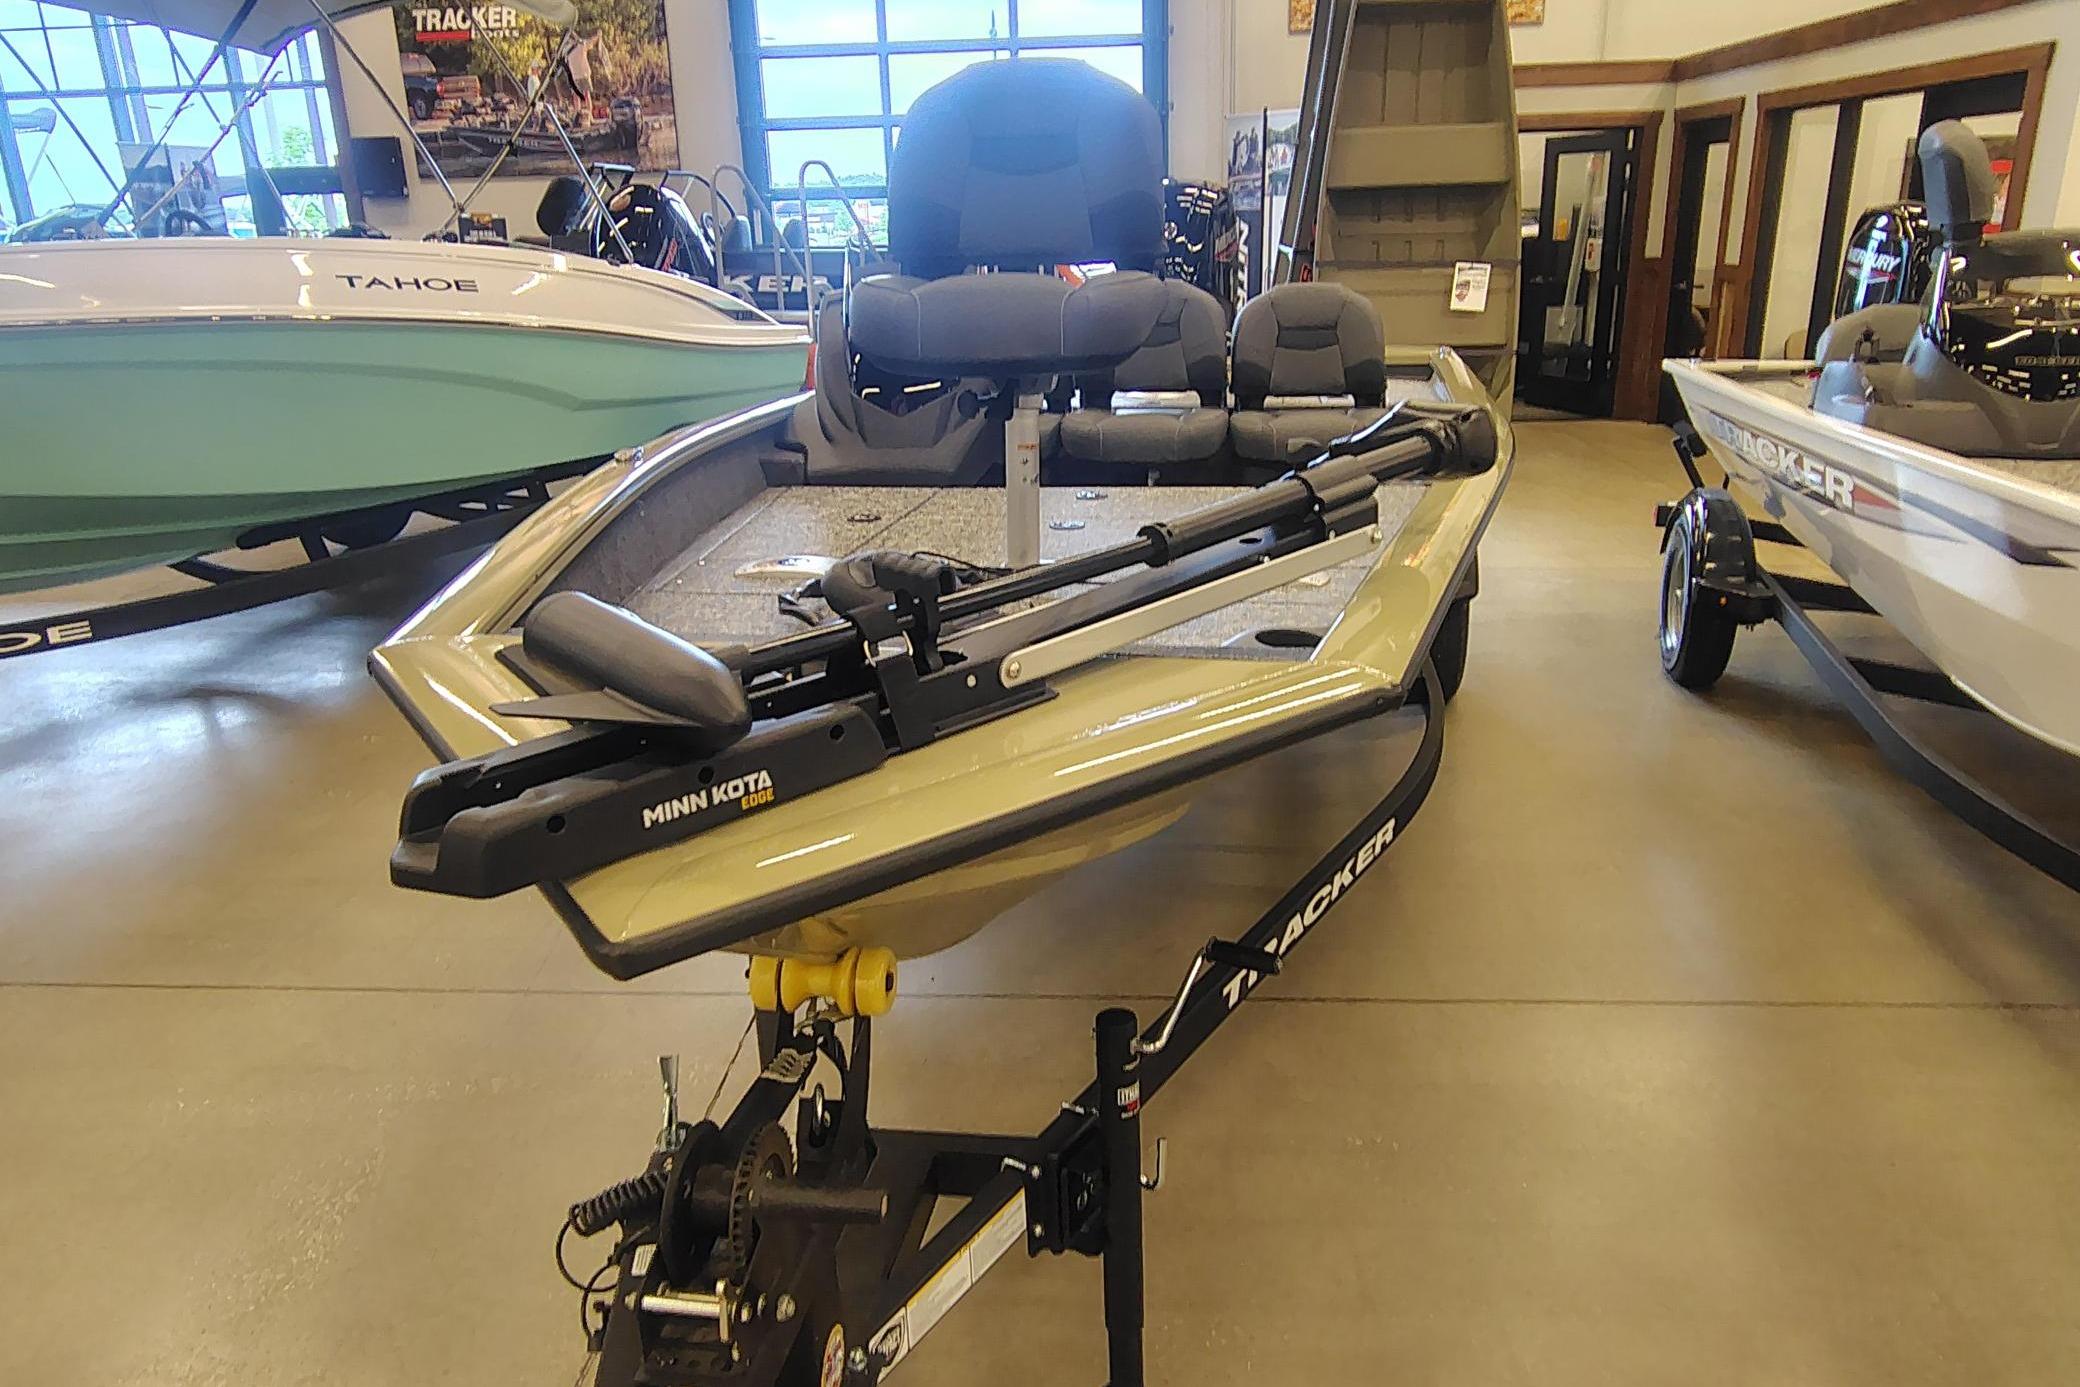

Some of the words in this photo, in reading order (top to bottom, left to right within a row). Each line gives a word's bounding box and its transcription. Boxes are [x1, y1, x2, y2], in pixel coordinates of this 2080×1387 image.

[412, 5, 517, 31] TRACKER
[335, 274, 479, 293] TAHOE
[1710, 410, 1855, 509] TRACKER
[642, 788, 708, 829] MINN
[711, 769, 773, 806] KOTA
[740, 786, 775, 811] EDGE
